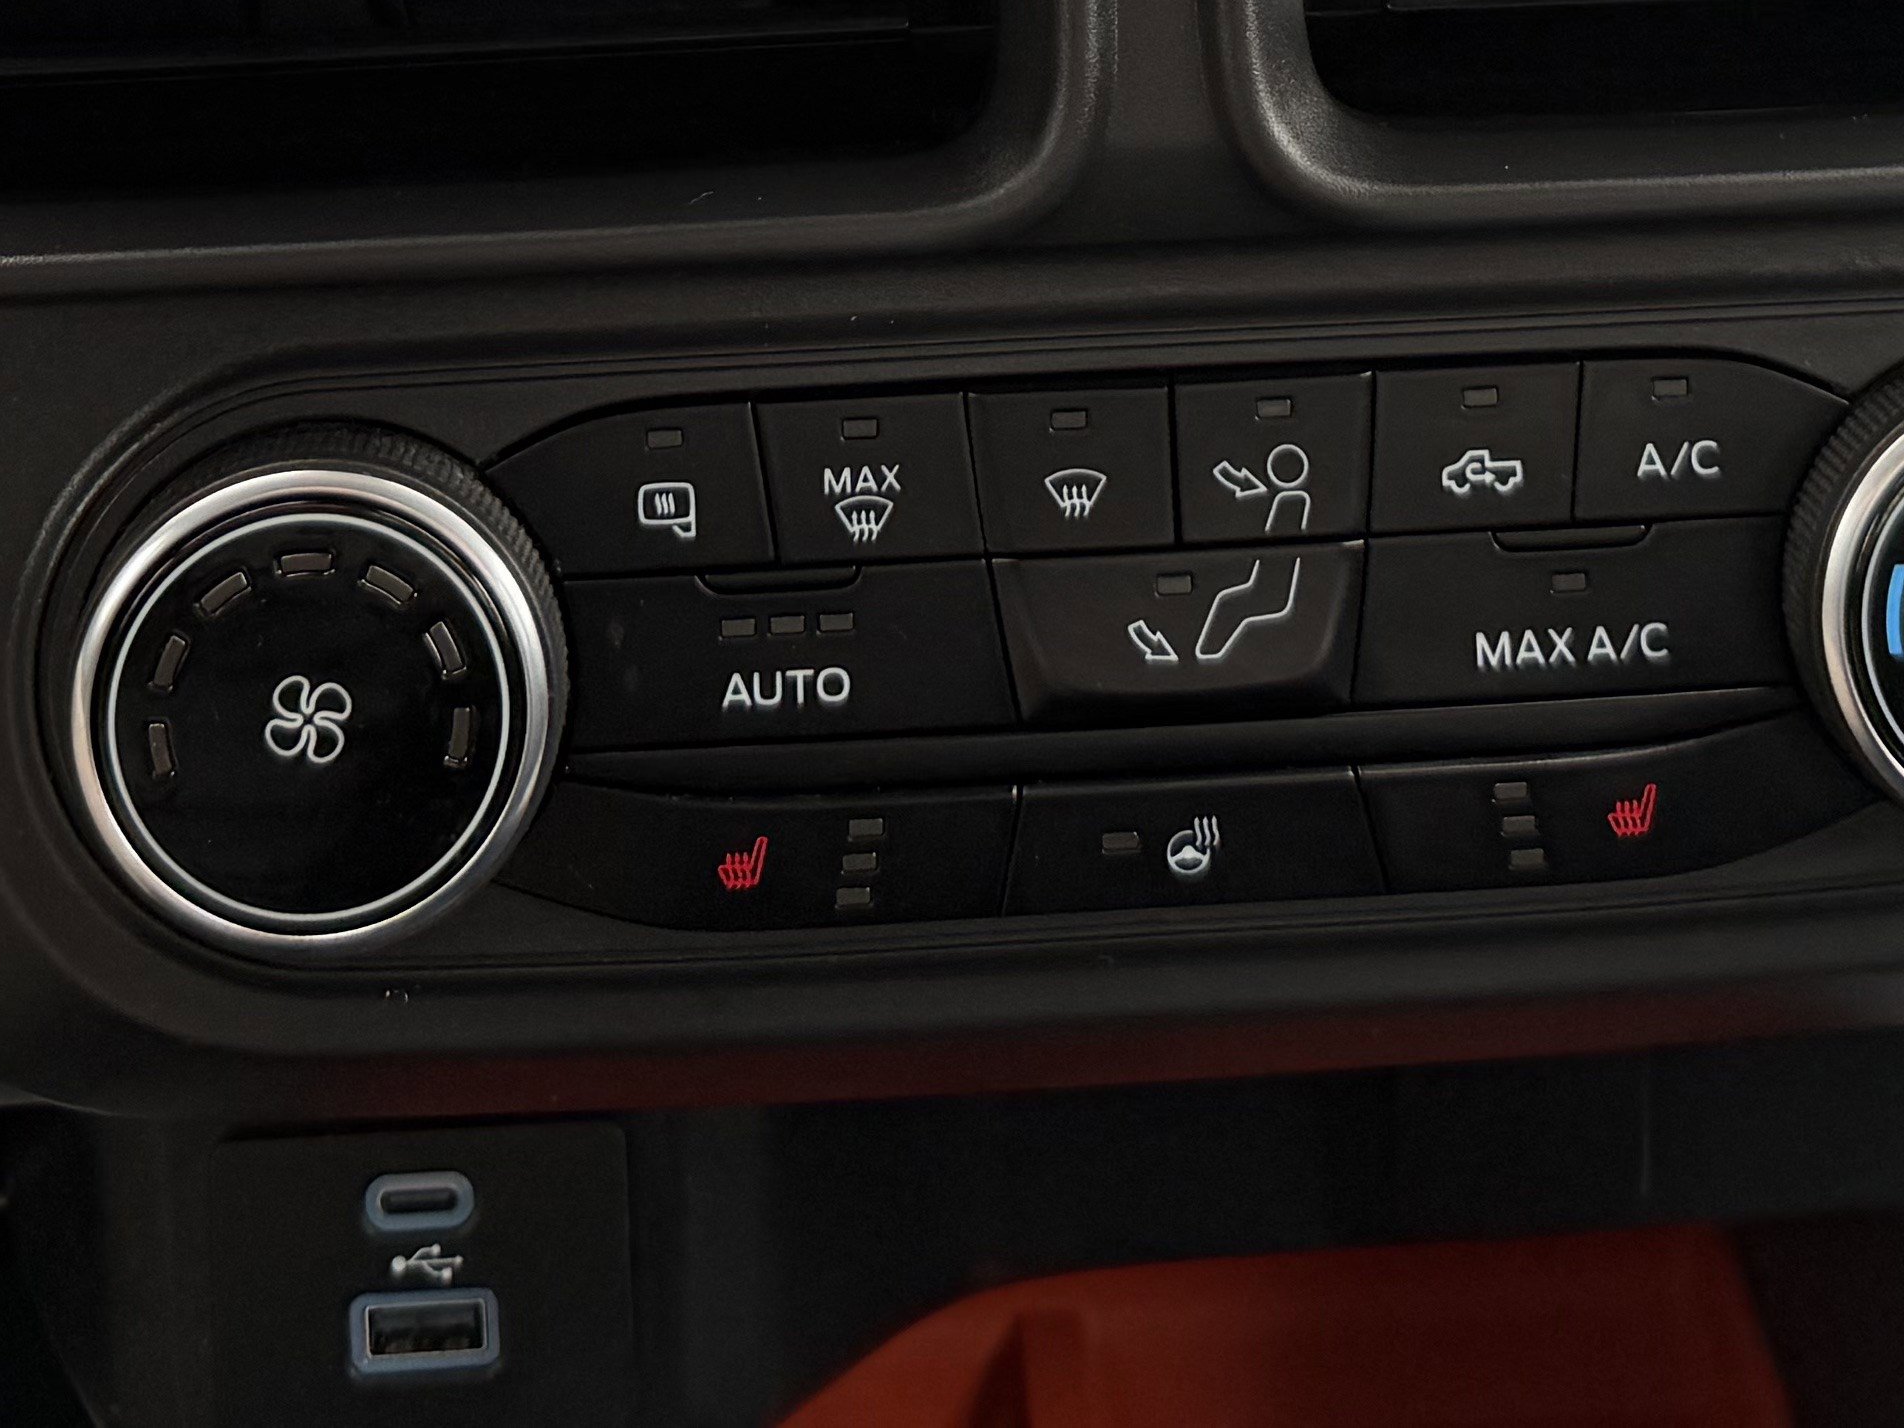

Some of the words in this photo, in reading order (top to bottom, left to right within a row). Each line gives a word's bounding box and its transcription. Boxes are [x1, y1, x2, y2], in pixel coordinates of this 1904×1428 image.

[822, 464, 902, 495] MAX
[1637, 439, 1722, 480] A/C
[1475, 626, 1575, 671] MAX
[1587, 622, 1670, 663] A/C
[722, 666, 852, 711] AUTO
